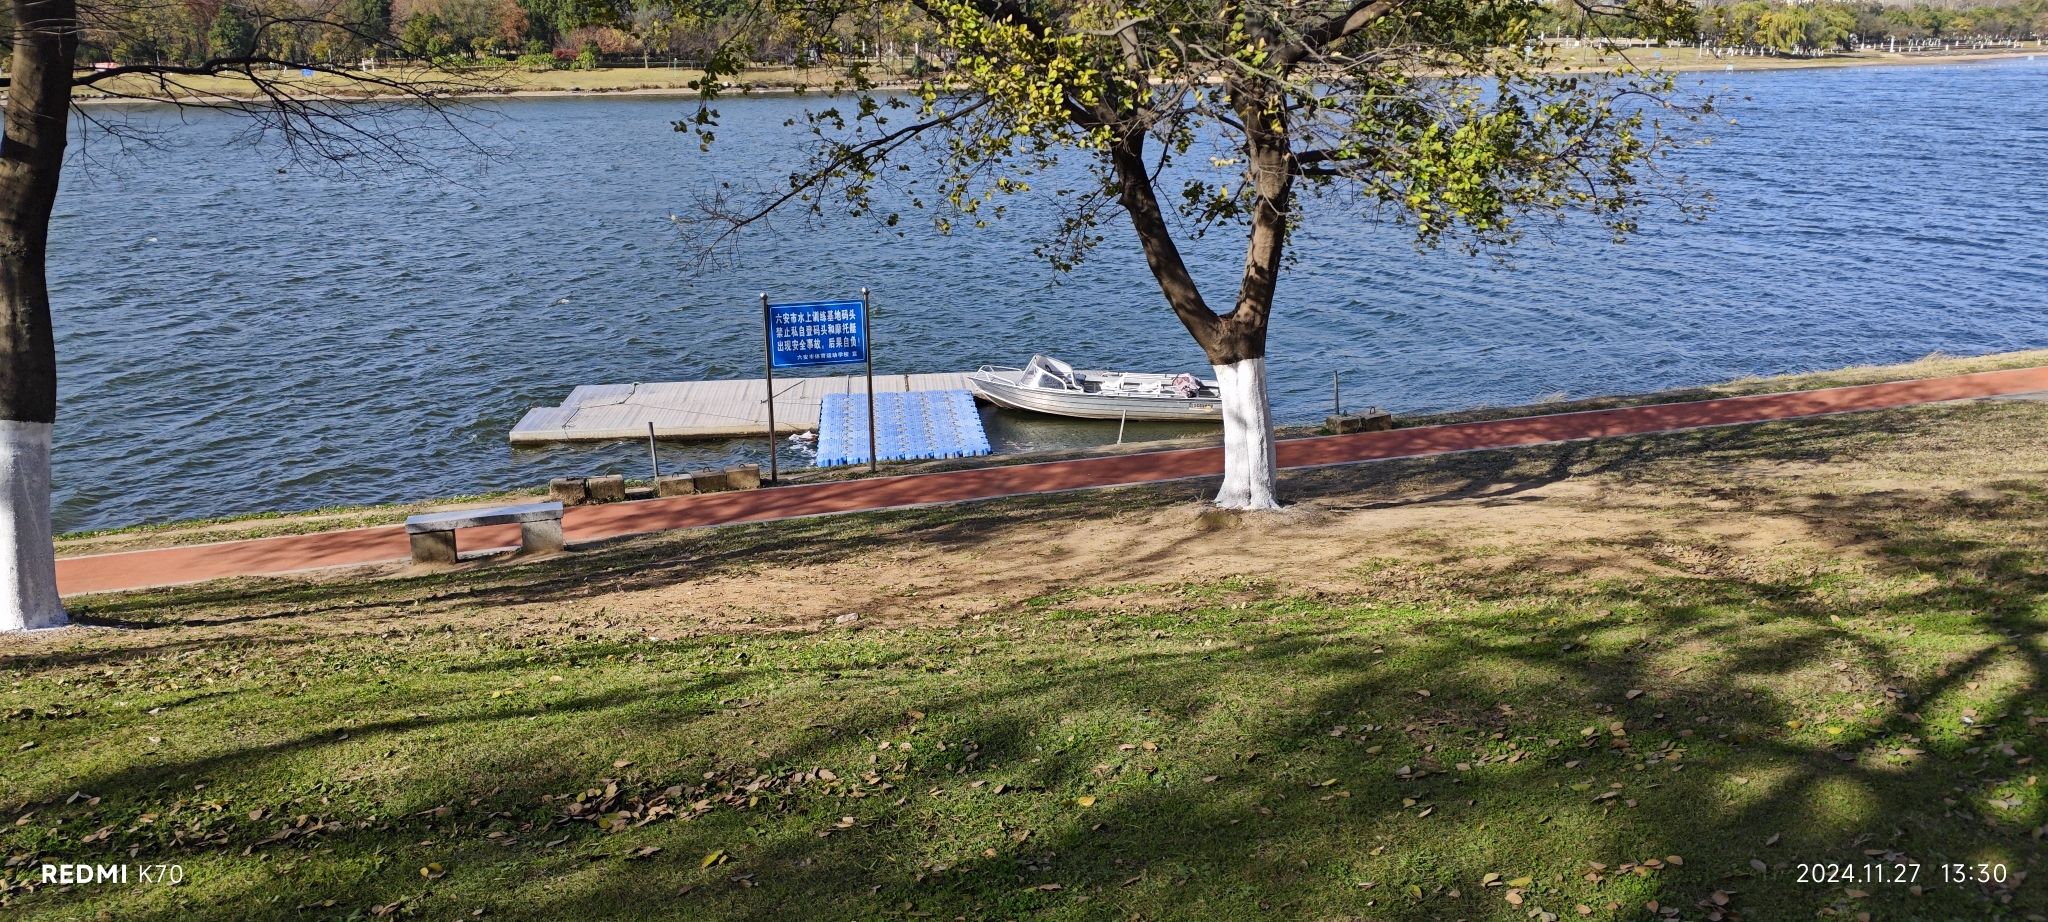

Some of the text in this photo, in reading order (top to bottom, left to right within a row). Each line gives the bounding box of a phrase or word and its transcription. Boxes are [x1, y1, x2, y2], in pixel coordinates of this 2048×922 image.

[775, 309, 856, 324] 六安市水上训练基地码头
